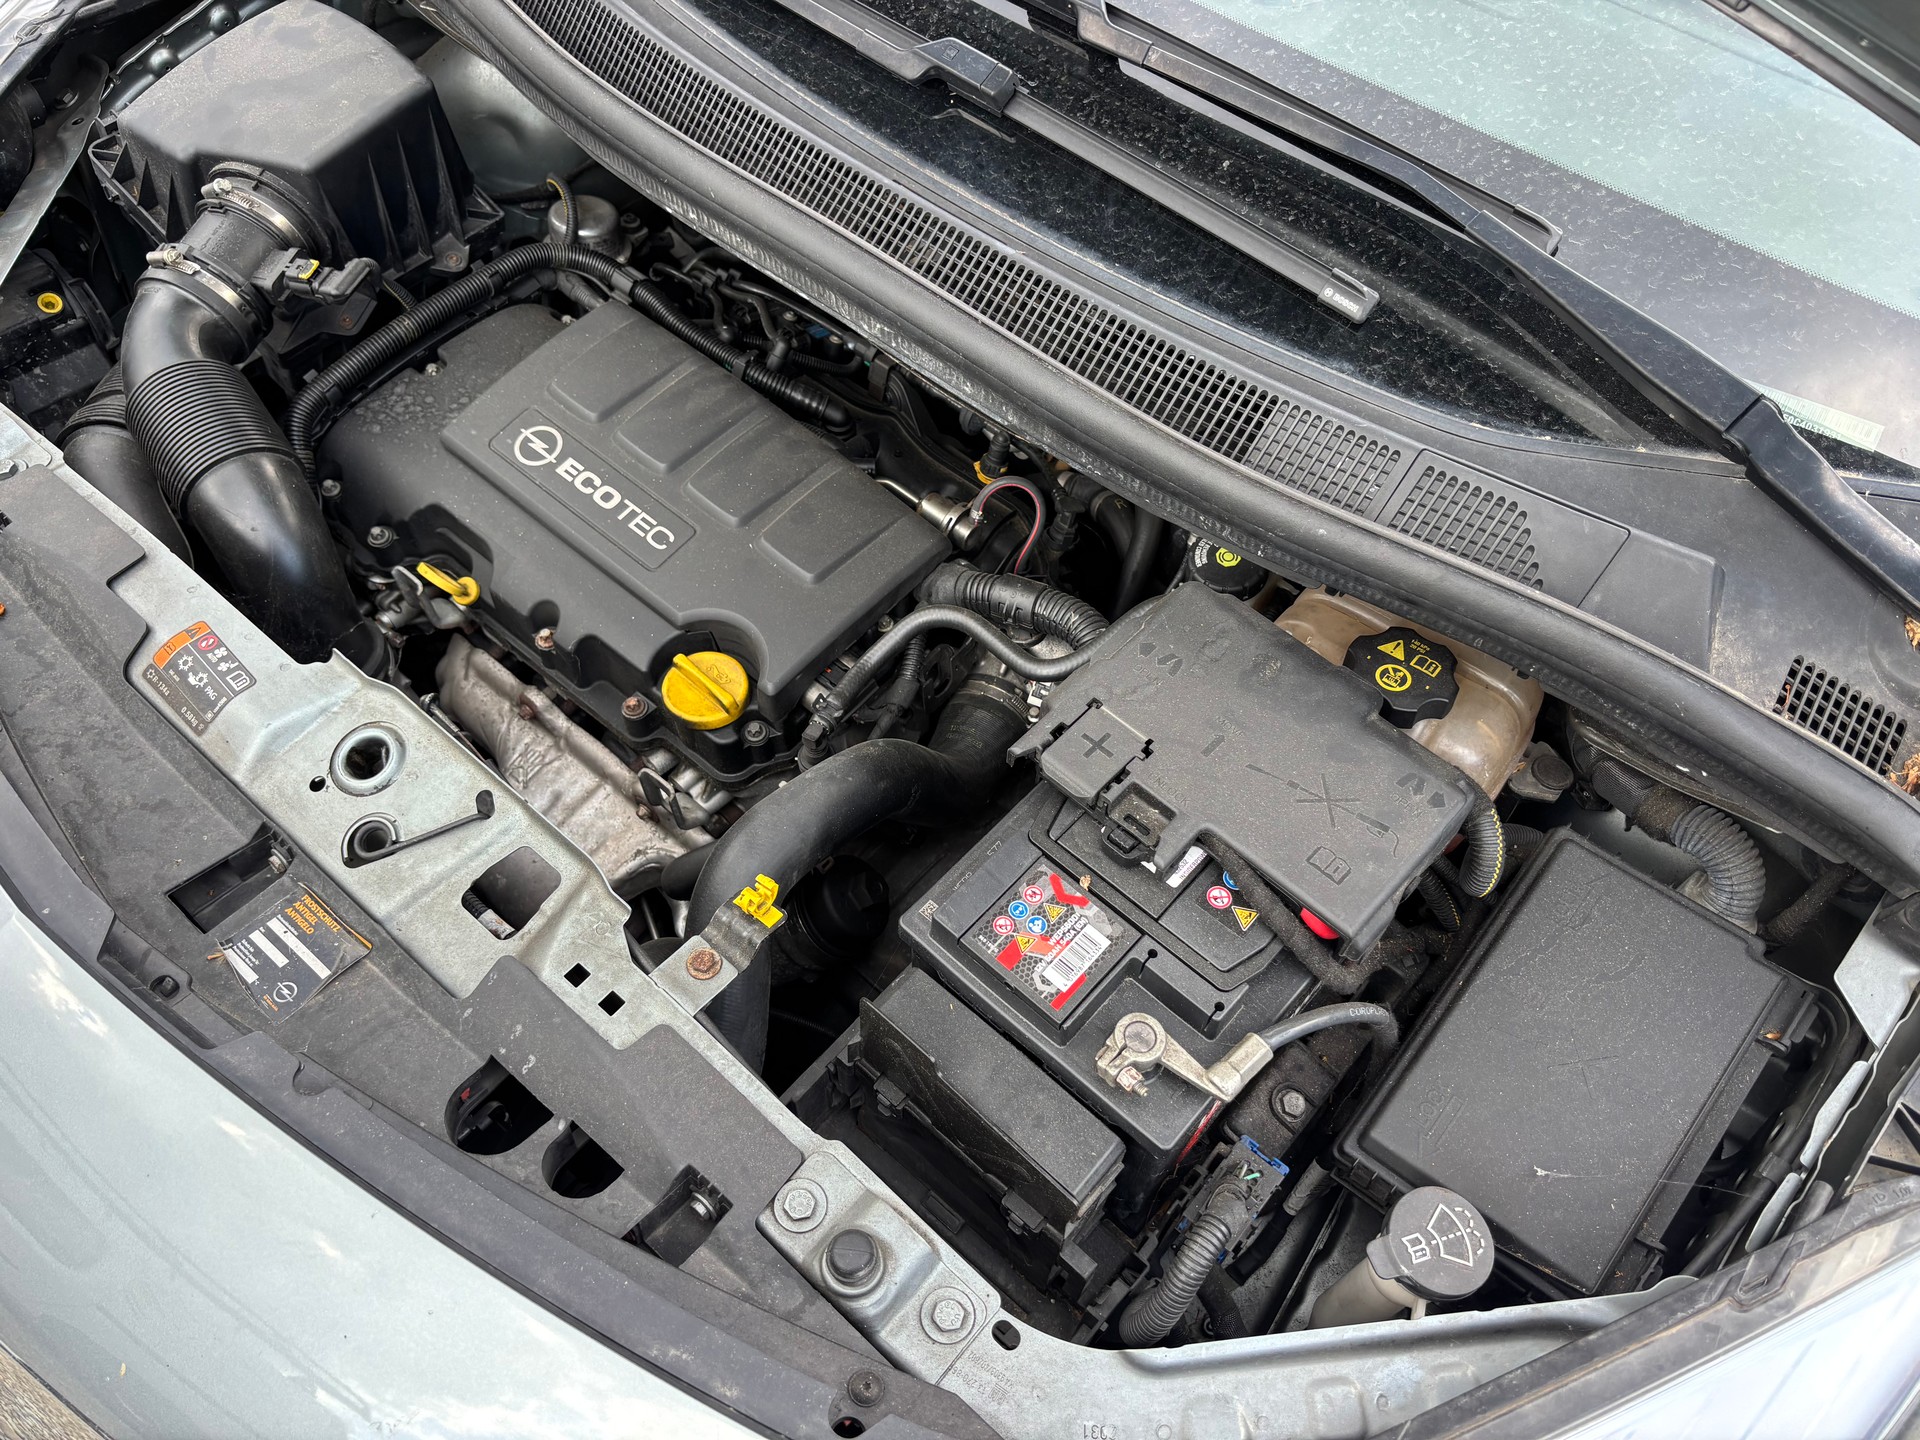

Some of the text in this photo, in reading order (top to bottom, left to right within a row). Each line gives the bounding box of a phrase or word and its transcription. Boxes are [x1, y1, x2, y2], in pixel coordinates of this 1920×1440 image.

[555, 457, 695, 550] ECOTEC
[151, 675, 171, 696] R-134a
[203, 685, 217, 700] PAG
[284, 907, 315, 934] ANTIGELO
[292, 901, 318, 925] ANTIGEL
[301, 893, 342, 932] FROSTSCHUTZ
[1034, 960, 1046, 972] 12V
[1058, 928, 1076, 946] 540A
[1073, 915, 1089, 932] (EN)
